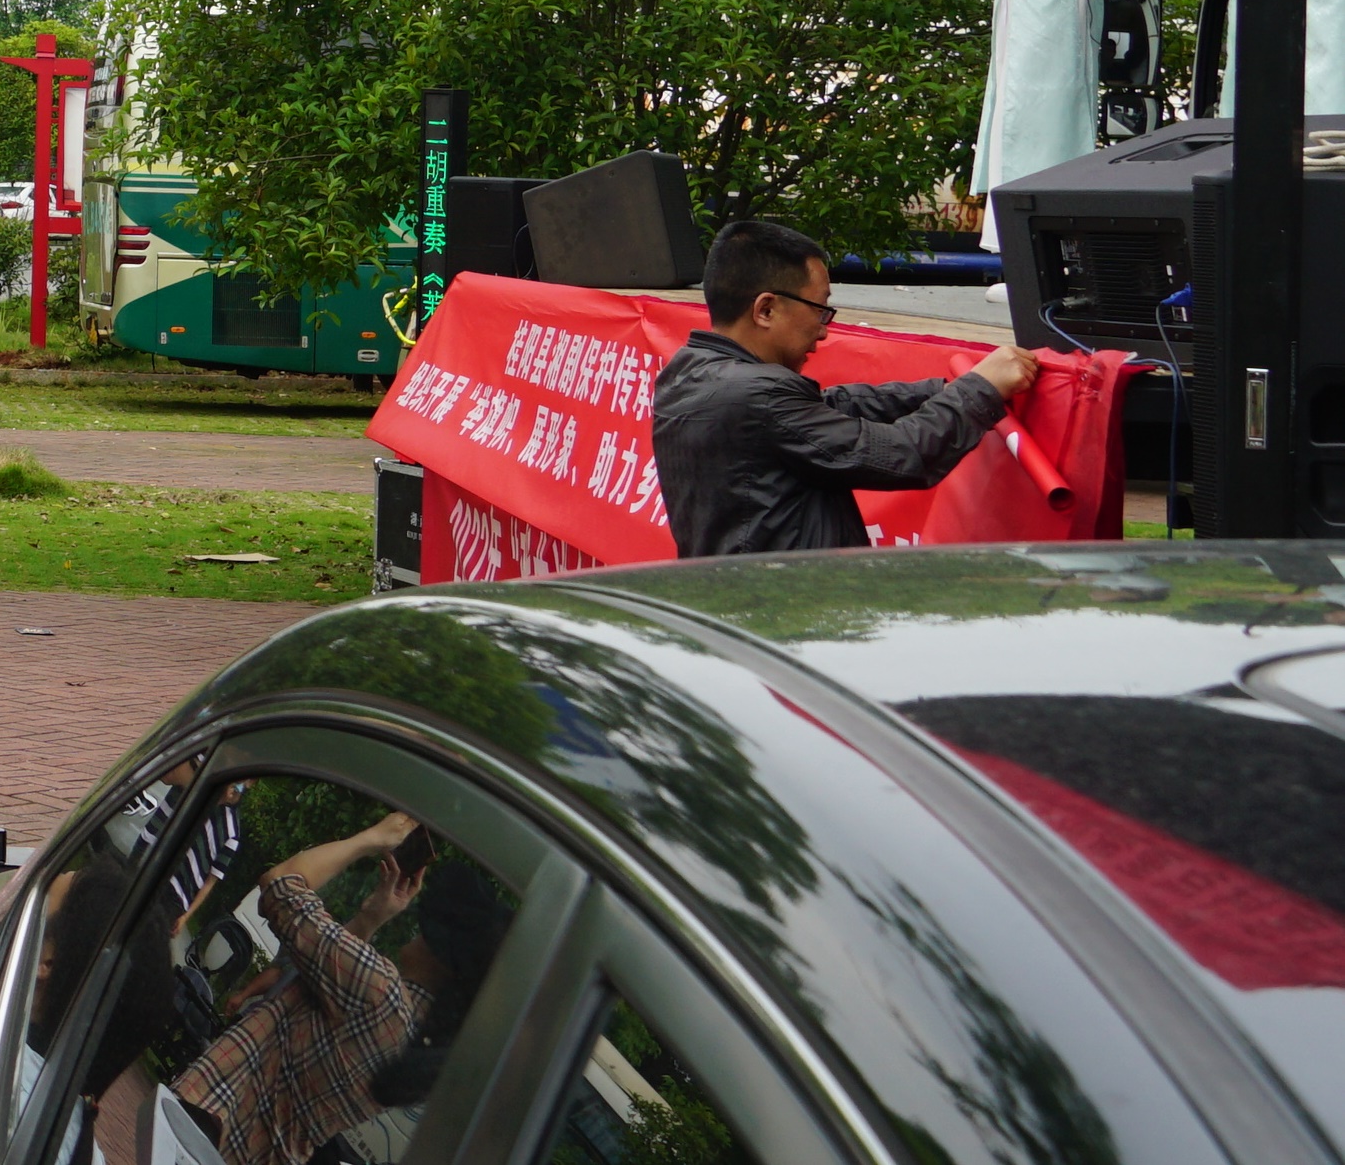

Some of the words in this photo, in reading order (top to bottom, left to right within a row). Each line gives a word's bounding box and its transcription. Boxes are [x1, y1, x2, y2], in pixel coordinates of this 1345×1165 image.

[504, 318, 663, 422] 桂阳县湘剧保护传承
